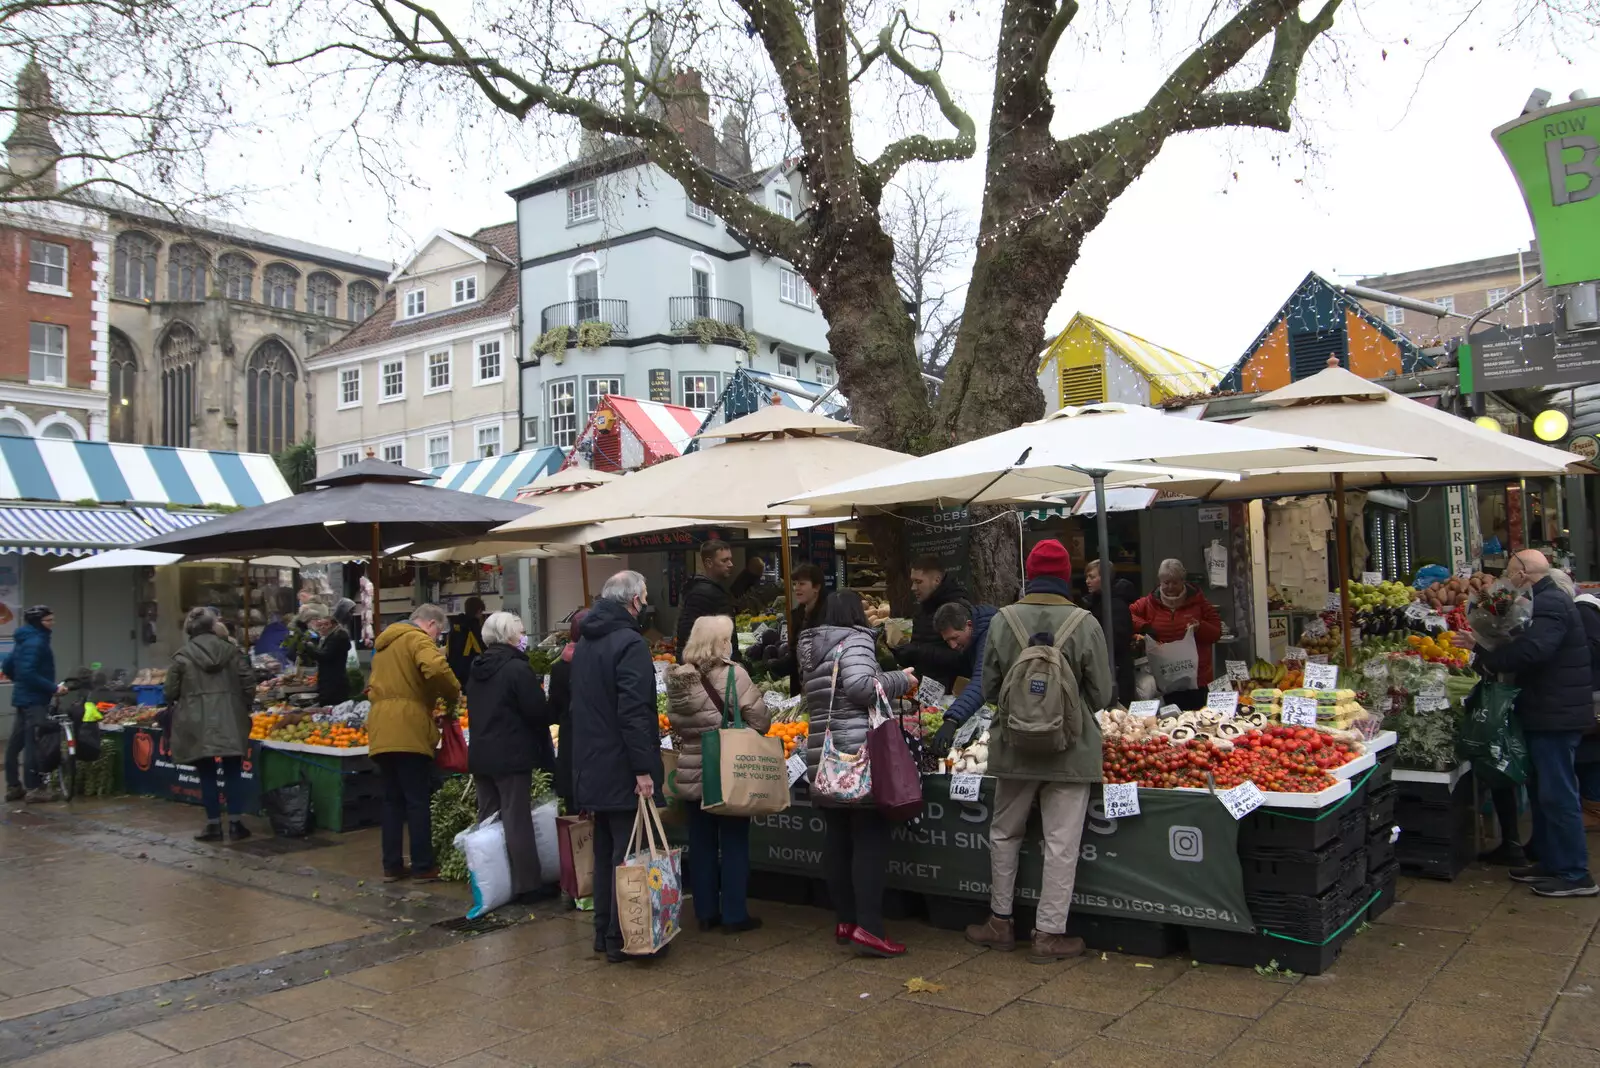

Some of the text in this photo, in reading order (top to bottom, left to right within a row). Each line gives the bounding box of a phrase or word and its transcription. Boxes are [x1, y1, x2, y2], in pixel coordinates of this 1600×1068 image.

[1544, 115, 1587, 139] ROW
[1544, 134, 1600, 207] B
[1571, 439, 1594, 450] Fruit
[933, 510, 968, 522] DEBS
[925, 521, 961, 535] SONS
[733, 763, 761, 771] HAPPEN
[732, 771, 747, 779] TIME
[749, 772, 764, 780] YOU
[959, 880, 992, 894] HOM
[1111, 897, 1165, 914] 01603
[1170, 903, 1239, 923] 305841
[627, 877, 645, 945] SEASALT
